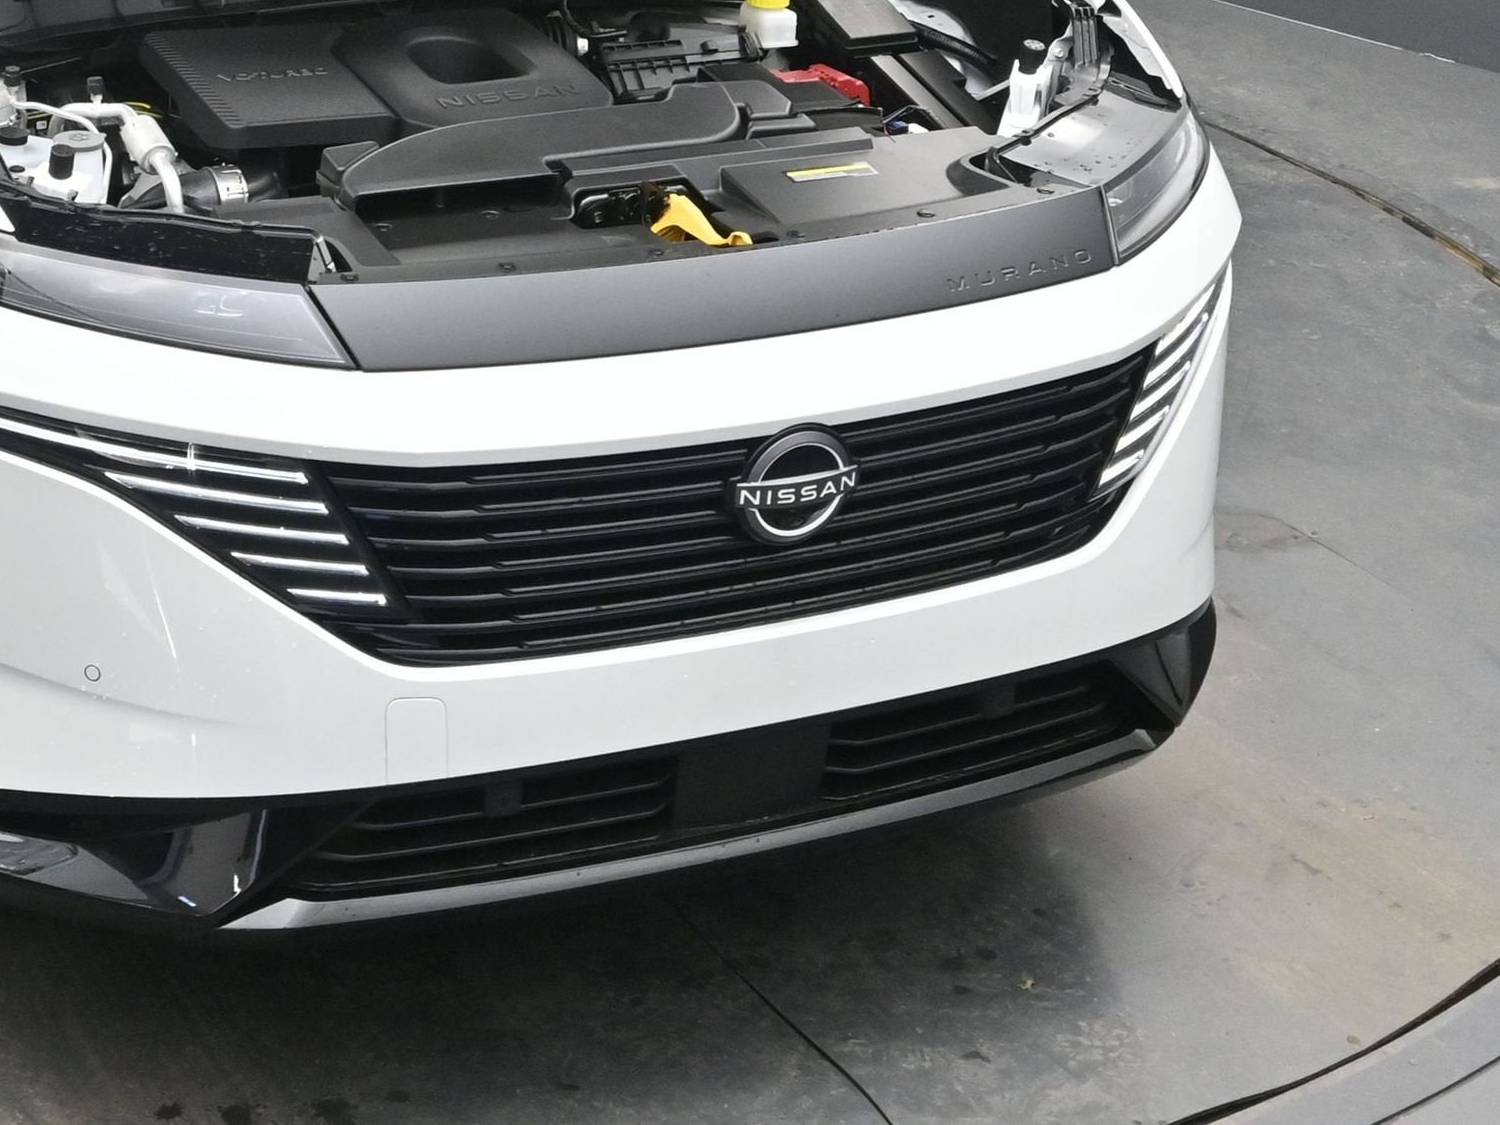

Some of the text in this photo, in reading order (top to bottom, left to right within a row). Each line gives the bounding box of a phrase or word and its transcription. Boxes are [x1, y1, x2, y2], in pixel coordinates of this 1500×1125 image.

[435, 83, 581, 109] NISSAN
[946, 248, 1092, 292] MURANO
[739, 471, 857, 507] NISSAN
